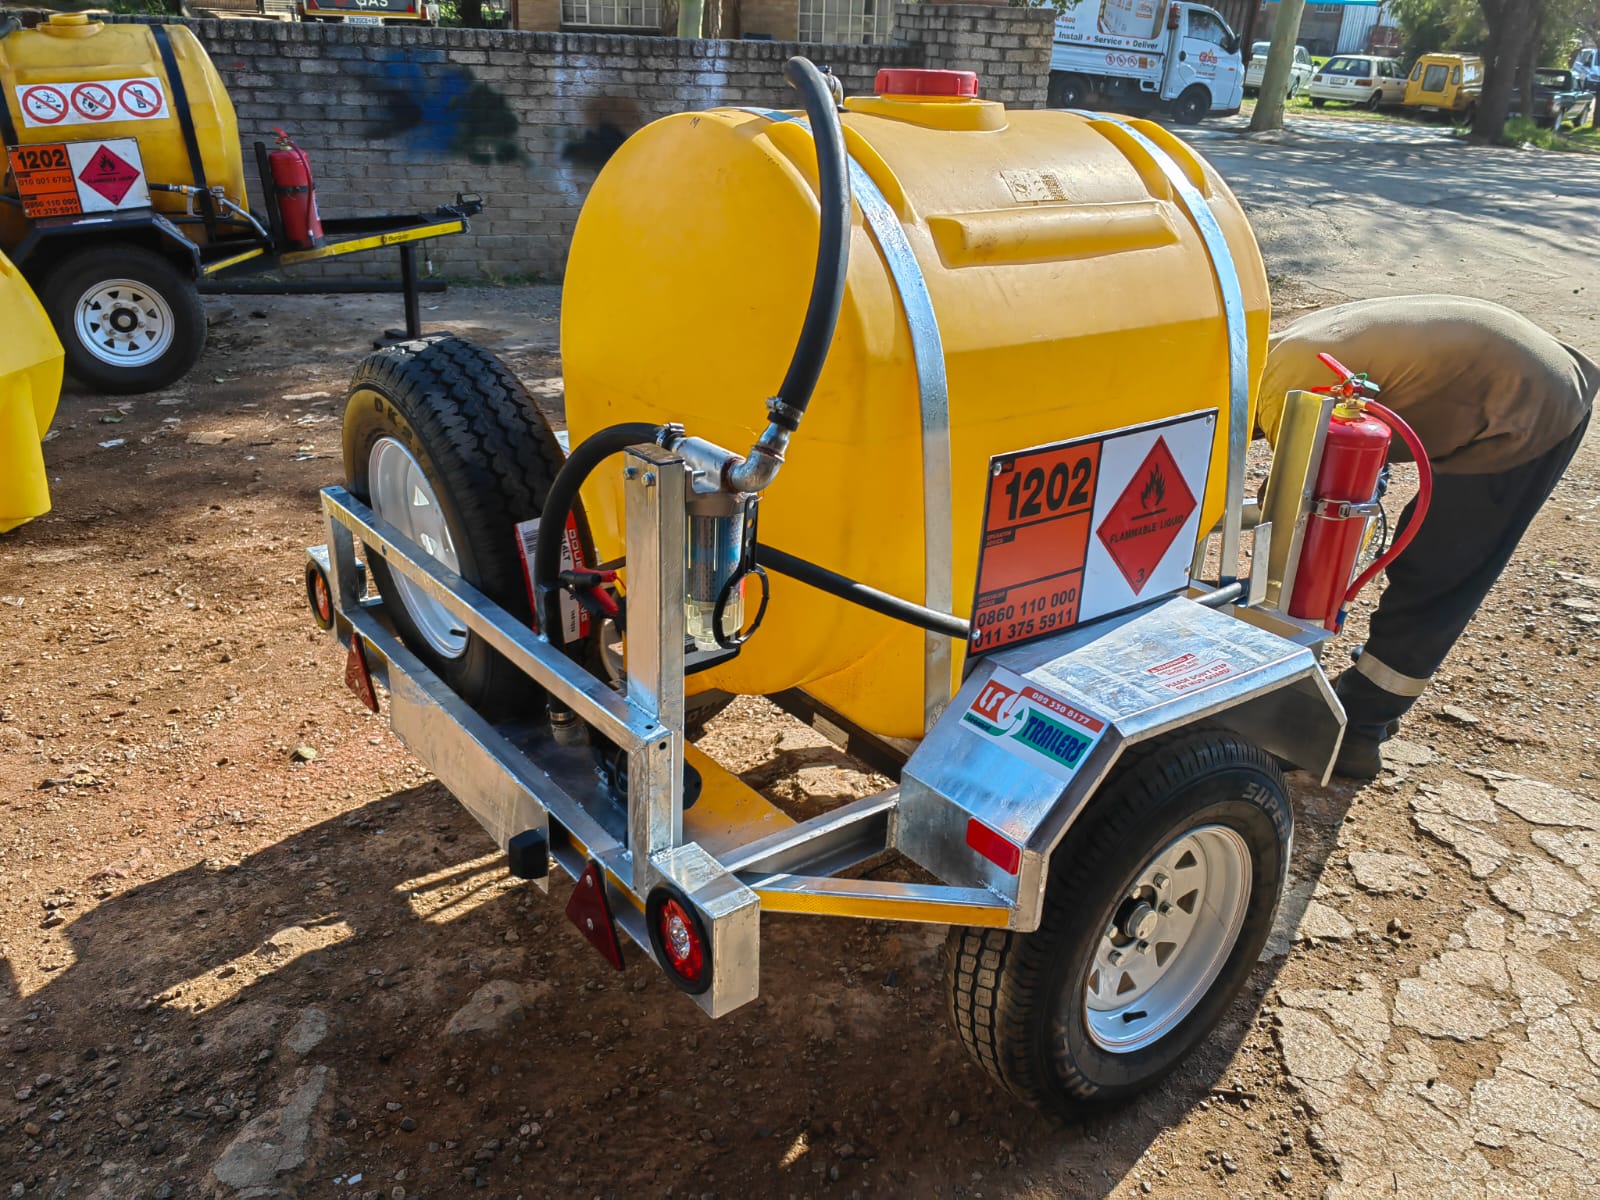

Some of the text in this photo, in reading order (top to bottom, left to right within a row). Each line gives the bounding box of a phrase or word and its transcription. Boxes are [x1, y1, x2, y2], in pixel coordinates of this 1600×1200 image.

[1058, 31, 1159, 50] Install Service Deliver
[18, 150, 66, 169] 1202
[1006, 457, 1093, 521] 1202
[1110, 515, 1184, 544] FLAMMABLE LIQUID
[1136, 568, 1146, 584] 3
[977, 604, 1015, 628] 0860
[1020, 597, 1047, 617] 110
[1050, 588, 1077, 606] 000
[974, 608, 1074, 648] 011 375 5911
[1165, 678, 1189, 688] PLEASE
[1211, 663, 1227, 672] STEP
[1189, 677, 1205, 686] MUD
[1031, 692, 1049, 705] 082
[1066, 709, 1091, 725] 8177
[1022, 715, 1088, 764] TRAILERS
